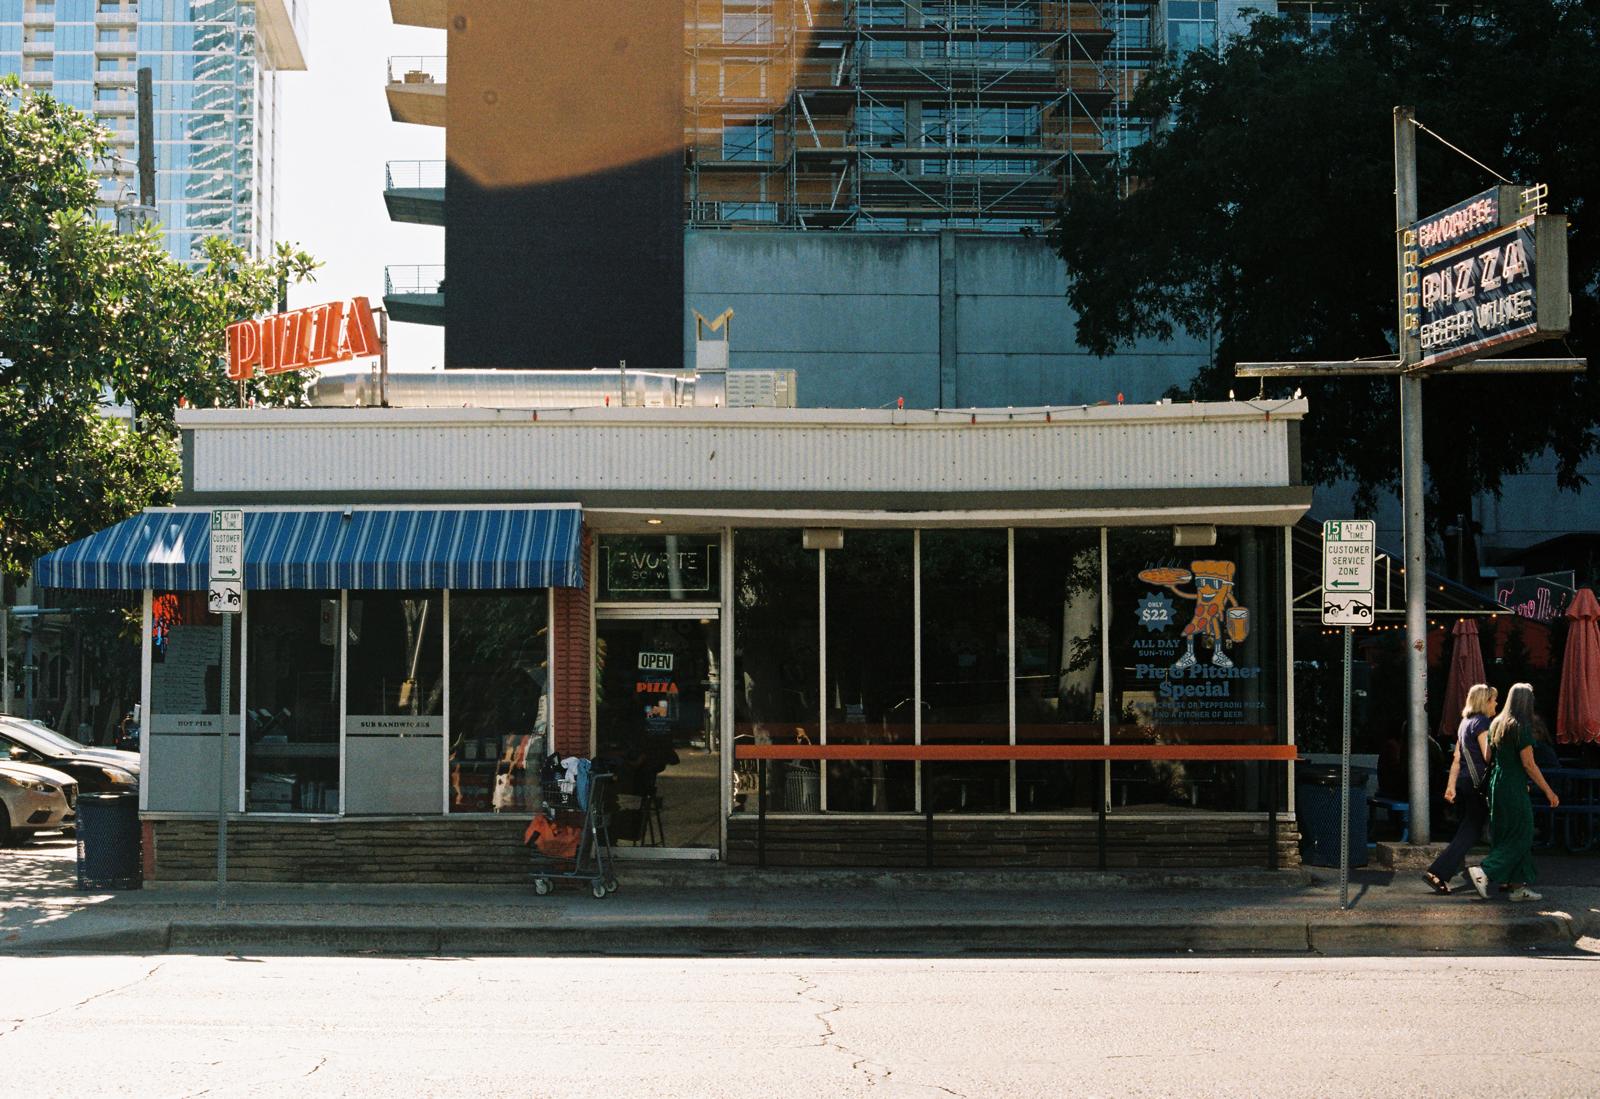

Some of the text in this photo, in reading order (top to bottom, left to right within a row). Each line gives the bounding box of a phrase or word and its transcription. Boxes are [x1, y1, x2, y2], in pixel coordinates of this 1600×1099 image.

[1422, 239, 1530, 312] PIZZA
[226, 297, 382, 380] PIZZA
[1327, 522, 1340, 534] 15
[213, 534, 240, 542] CUSTOMER
[215, 545, 237, 553] SERVICE
[1328, 546, 1370, 554] CUSTOMER
[219, 556, 233, 564] ZONE
[619, 552, 698, 570] FAVORTE
[1332, 557, 1365, 565] SERVICE
[1338, 567, 1359, 575] ZONE
[1142, 609, 1169, 621] $22
[1133, 640, 1179, 648] ALL DAY
[641, 654, 671, 668] OPEN
[1135, 664, 1166, 679] Pie
[1188, 664, 1260, 679] Pitcher
[635, 681, 679, 694] PIZZA
[1159, 681, 1231, 699] Special
